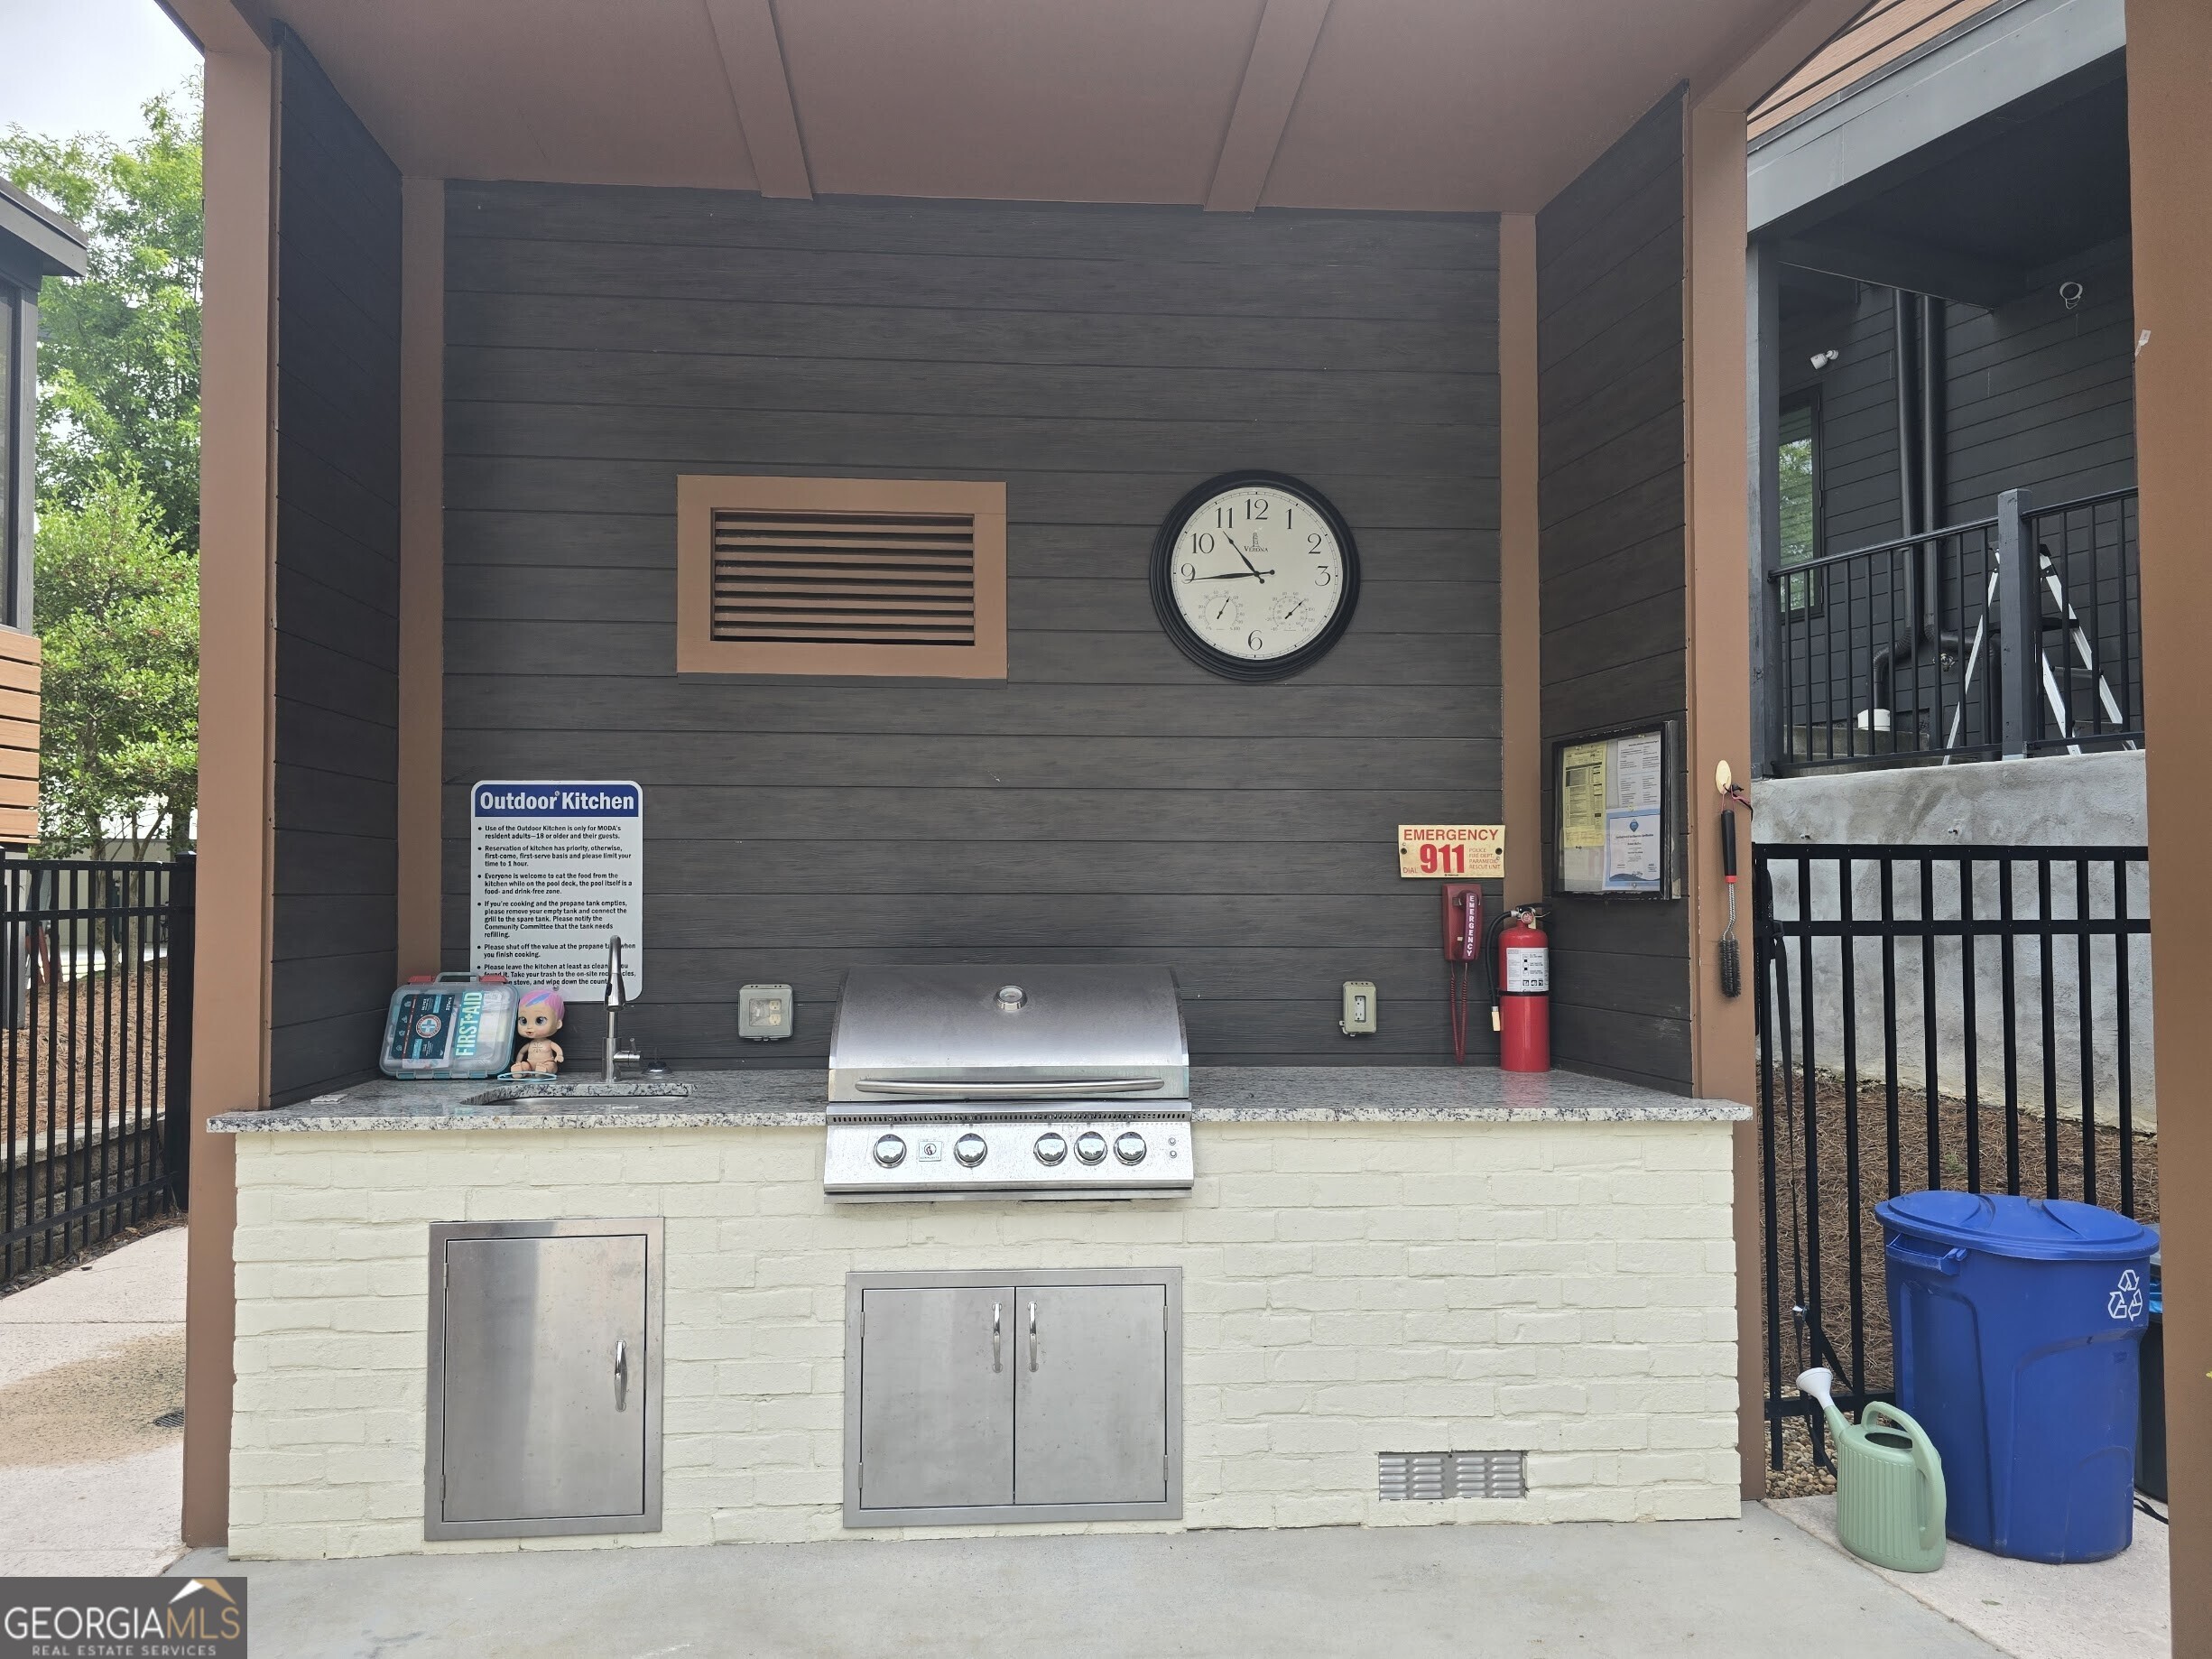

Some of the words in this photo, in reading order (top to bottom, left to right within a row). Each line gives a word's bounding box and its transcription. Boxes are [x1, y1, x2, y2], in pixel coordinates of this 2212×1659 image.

[1216, 507, 1234, 529] 11
[1245, 498, 1269, 520] 12
[1285, 508, 1293, 530] 1
[1190, 533, 1215, 554] 10
[1307, 533, 1322, 554] 2
[1180, 562, 1196, 585] 9
[1314, 565, 1331, 587] 3
[1247, 630, 1263, 651] 6
[480, 792, 558, 810] Outdoor
[561, 792, 634, 810] Kitchen
[1403, 829, 1499, 841] EMERGENCY
[1420, 843, 1465, 874] 911
[485, 872, 512, 881] Everyone
[590, 879, 604, 888] pool
[484, 915, 496, 923] grill
[484, 922, 519, 931] Community
[1466, 895, 1476, 957] EMERGENCY
[546, 978, 560, 987] wipe
